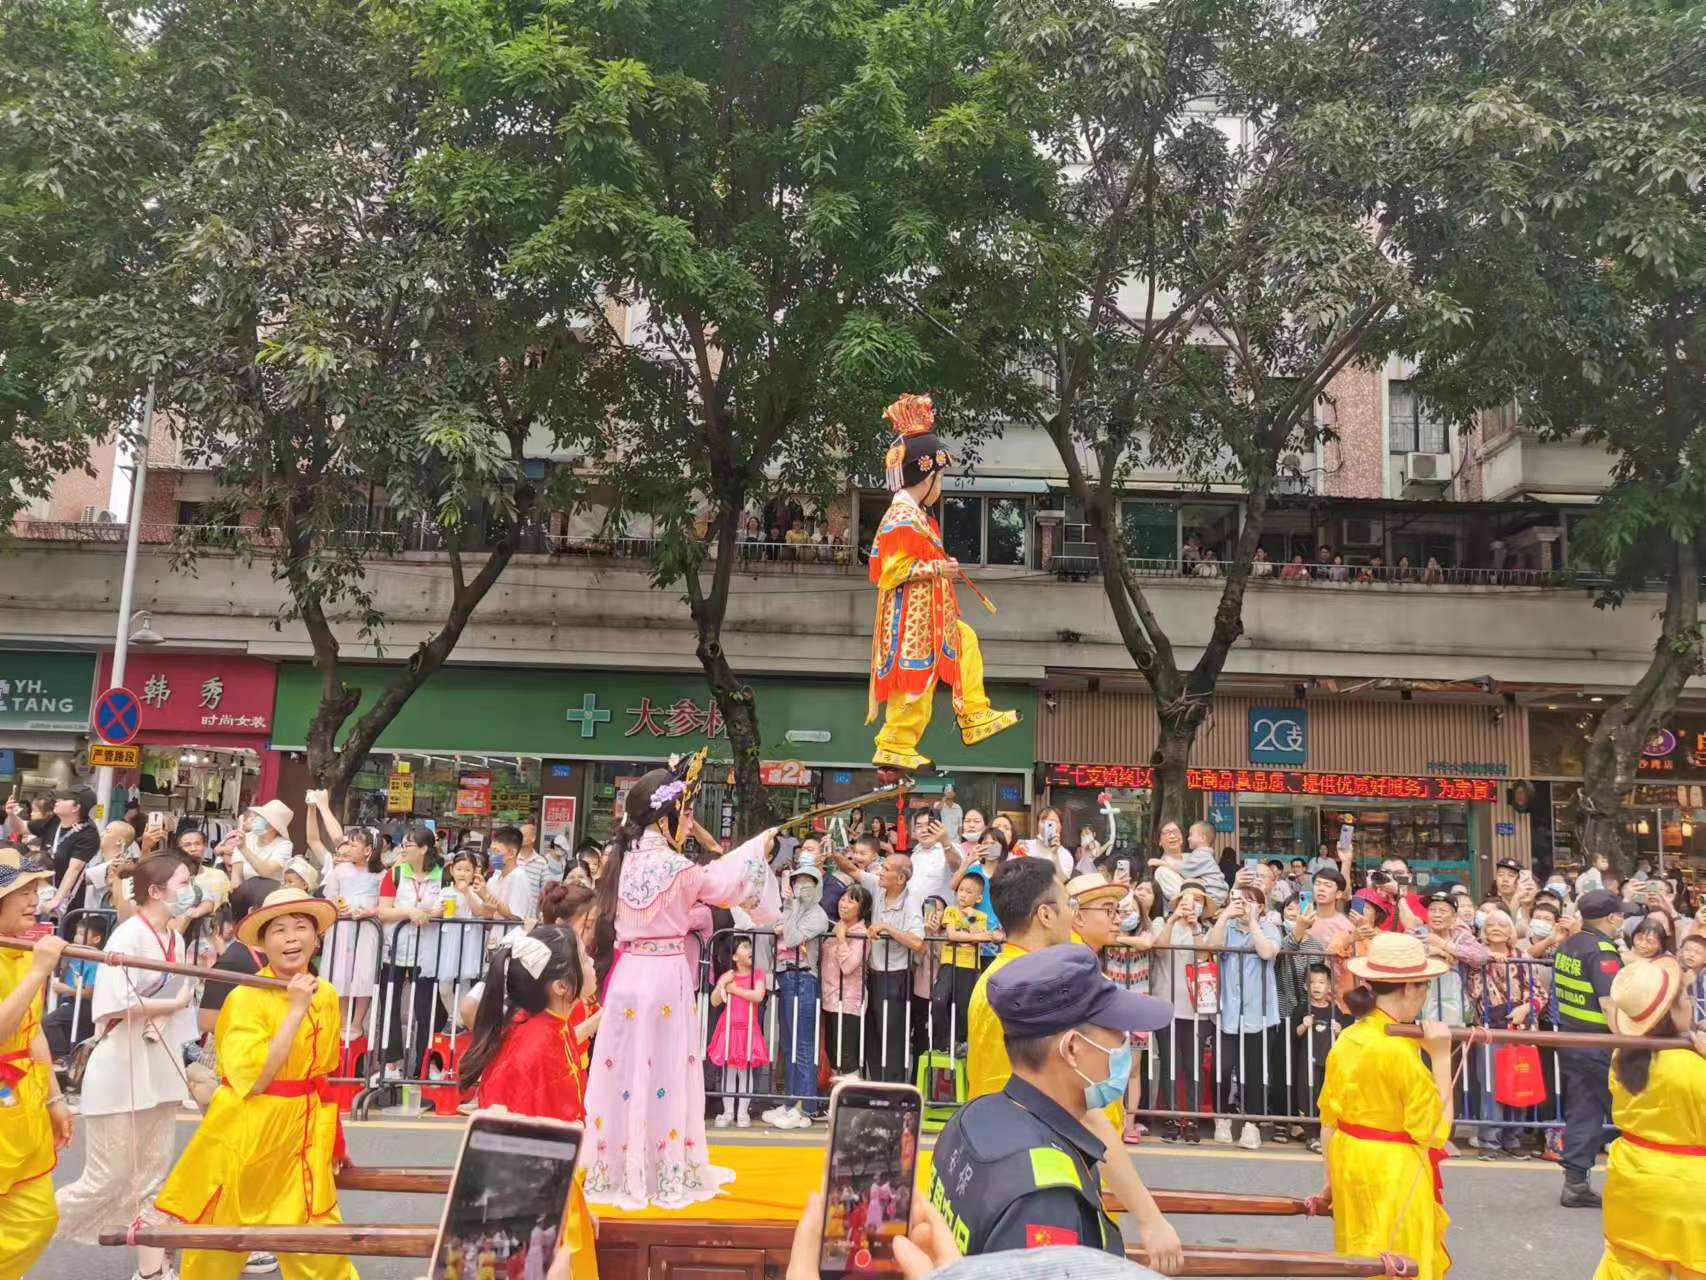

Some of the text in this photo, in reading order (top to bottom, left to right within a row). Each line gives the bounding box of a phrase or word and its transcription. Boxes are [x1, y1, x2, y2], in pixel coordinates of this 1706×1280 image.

[14, 679, 48, 694] YH.
[139, 673, 224, 710] 韩秀
[11, 697, 74, 713] TANG
[201, 713, 267, 729] 时尚女装
[92, 749, 136, 764] 严管路段
